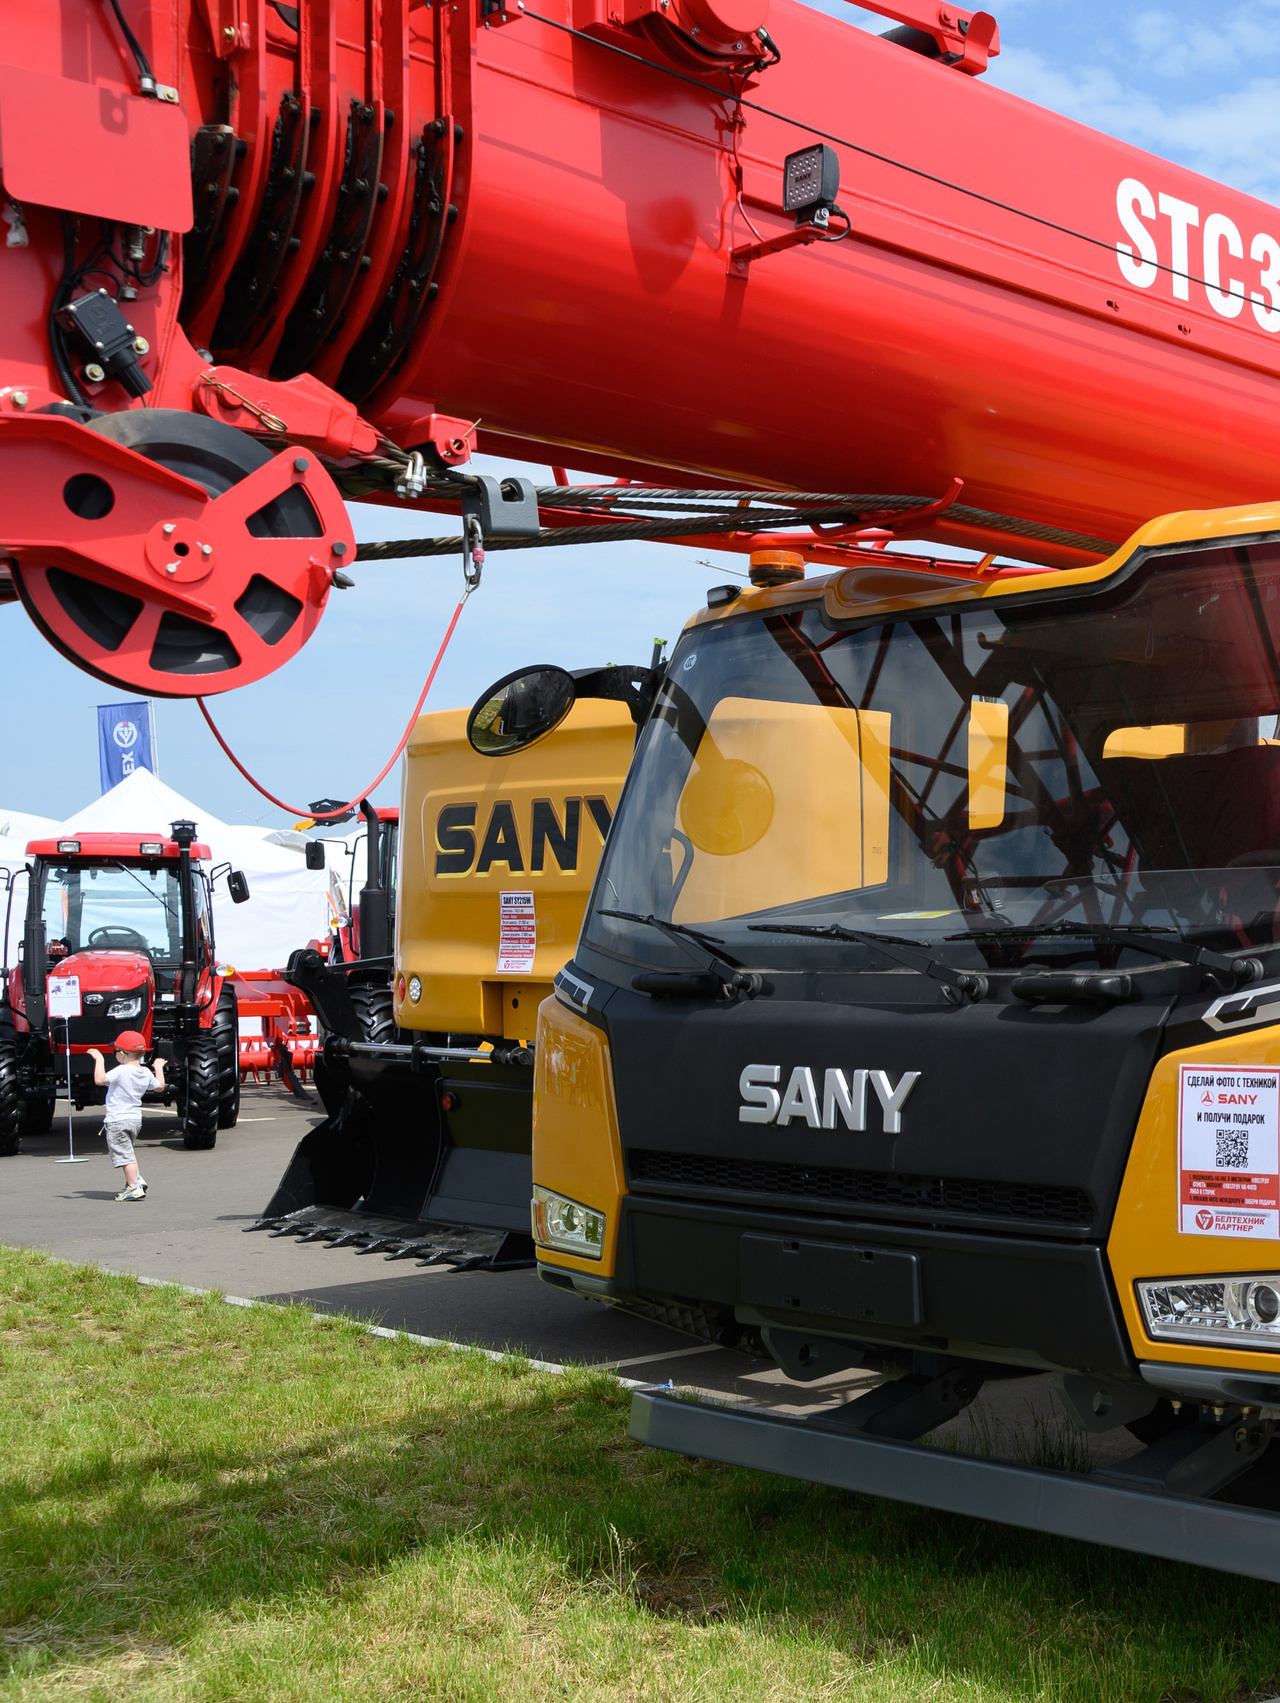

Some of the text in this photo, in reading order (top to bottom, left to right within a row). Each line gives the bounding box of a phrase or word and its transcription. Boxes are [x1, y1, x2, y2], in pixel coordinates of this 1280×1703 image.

[794, 172, 812, 184] SANY
[1187, 1075, 1277, 1088] СДЕЛАЙ ФОТО С ТЕХНИКОЙ
[738, 1064, 922, 1134] SANY
[1218, 1094, 1258, 1105] SANY
[1197, 1112, 1265, 1125] И ПОЛУЧИ ПОДАРОК
[1215, 1216, 1265, 1225] БЕЛТЕХНИК
[1214, 1223, 1253, 1232] ПАРТНЕР
